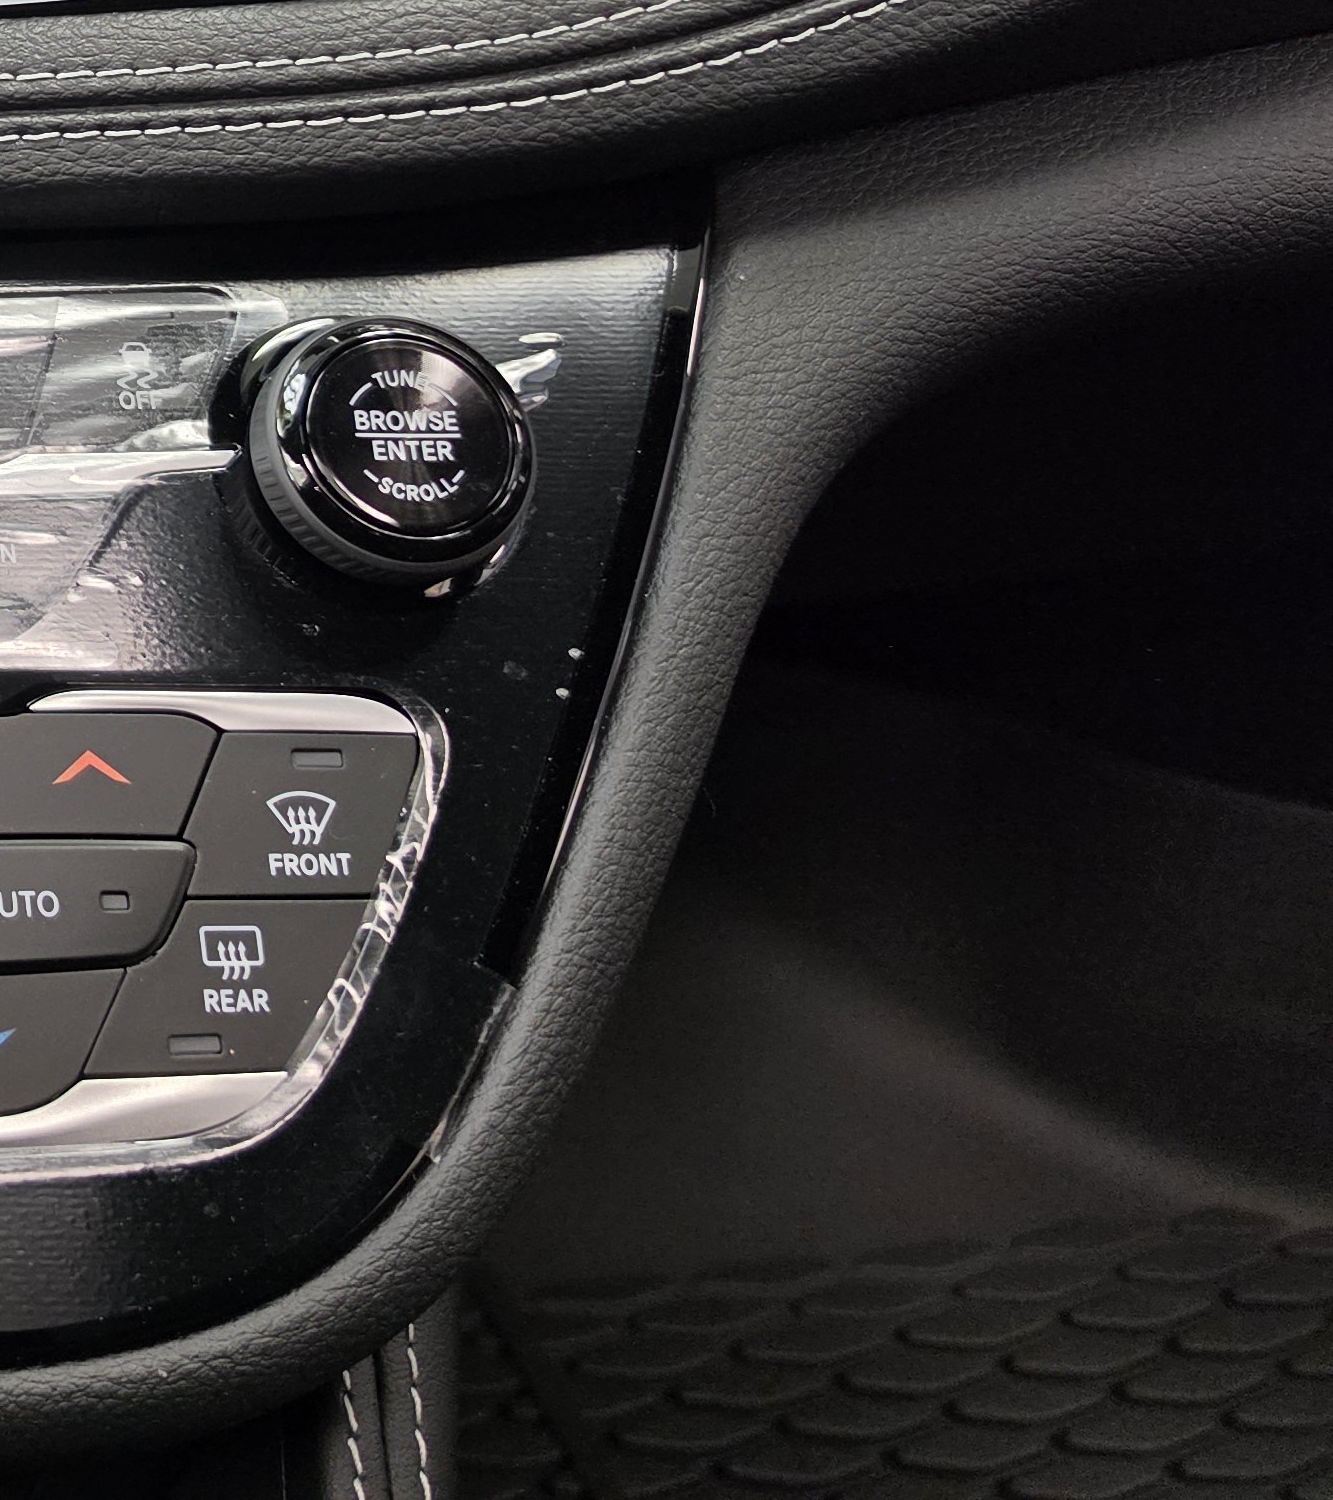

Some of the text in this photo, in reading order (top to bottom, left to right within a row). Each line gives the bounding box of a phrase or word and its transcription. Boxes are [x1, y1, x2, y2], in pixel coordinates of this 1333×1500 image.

[371, 369, 429, 390] TUNE
[117, 391, 163, 411] OFF
[353, 409, 460, 432] BROWSE
[371, 439, 455, 462] ENTER
[377, 476, 459, 502] SCROLL
[267, 852, 351, 878] FRONT
[202, 987, 270, 1014] REAR
